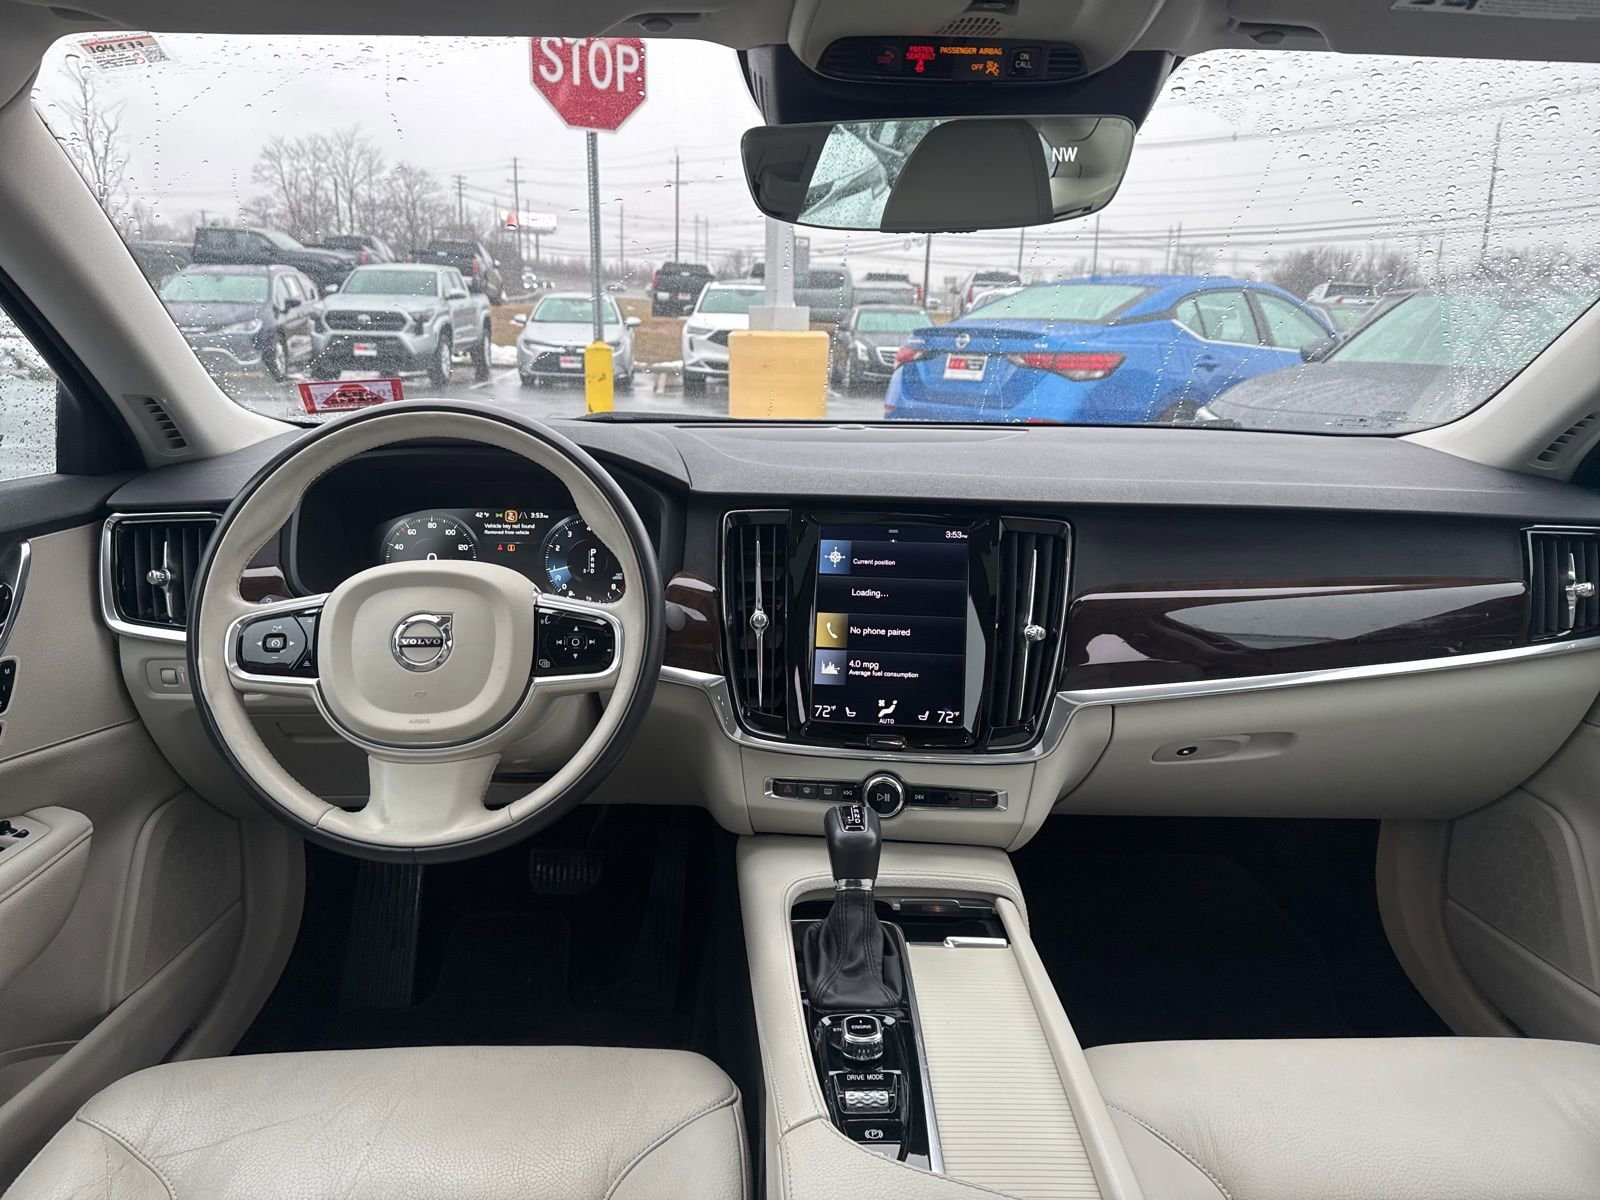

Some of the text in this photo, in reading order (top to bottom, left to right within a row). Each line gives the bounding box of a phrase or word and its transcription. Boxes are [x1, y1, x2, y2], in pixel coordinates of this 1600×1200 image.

[940, 46, 1002, 56] PASSENGER AIRBAG
[539, 37, 640, 92] STOP
[1015, 60, 1032, 69] CALL
[1052, 147, 1078, 162] NW
[852, 589, 889, 598] Loading...
[863, 627, 886, 636] phone
[887, 628, 910, 637] paired
[849, 660, 879, 670] 4.0 mpg
